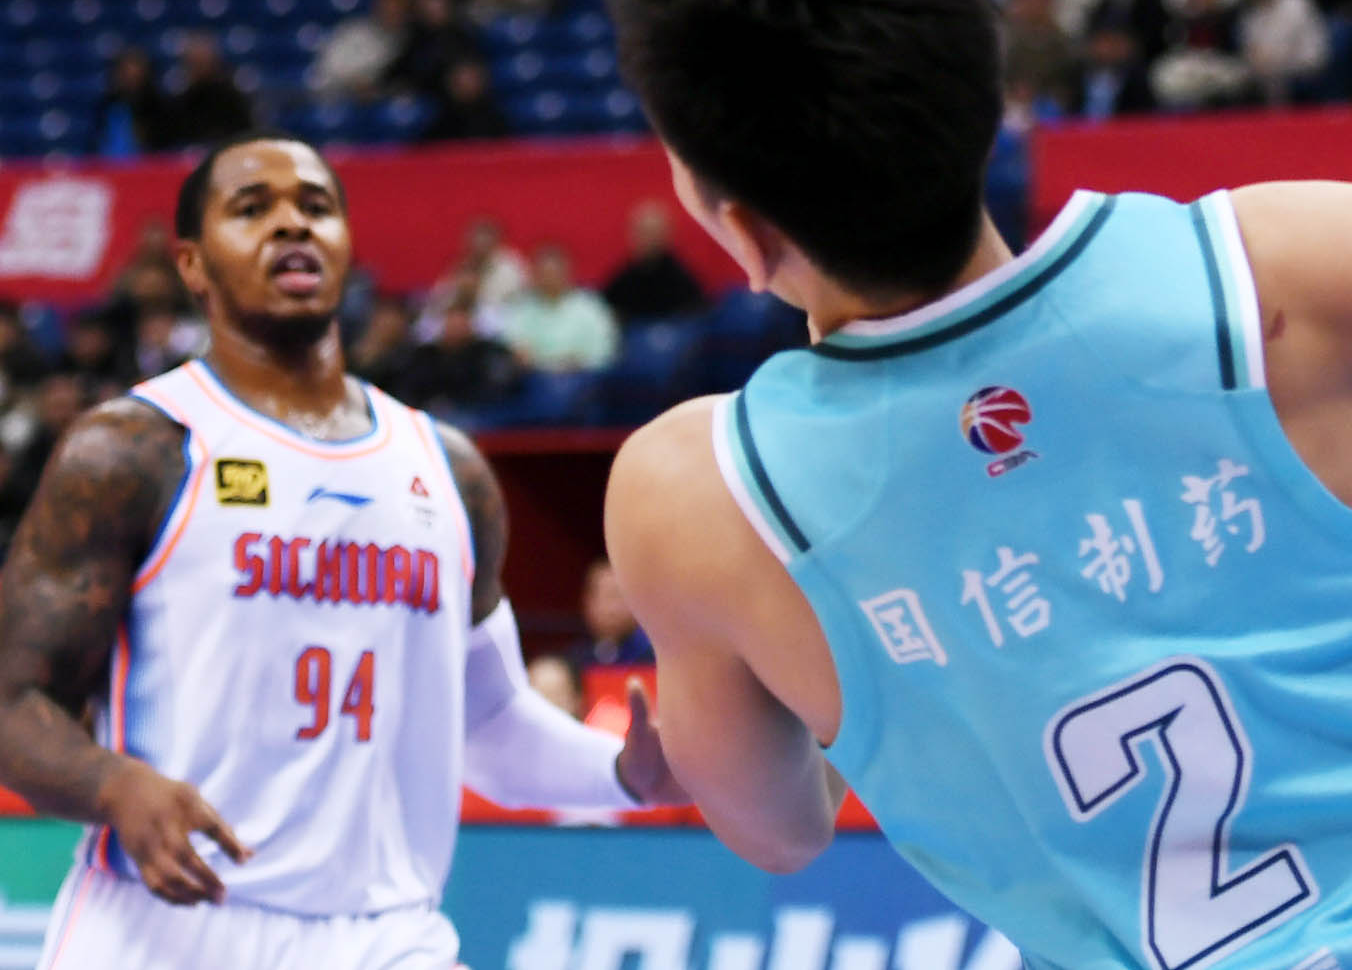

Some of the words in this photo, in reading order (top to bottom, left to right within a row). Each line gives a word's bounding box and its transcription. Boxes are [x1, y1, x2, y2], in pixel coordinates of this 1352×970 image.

[233, 532, 440, 616] SICHUAN
[858, 458, 1267, 667] 国信制药
[294, 645, 375, 743] 94
[1042, 654, 1319, 970] 2
